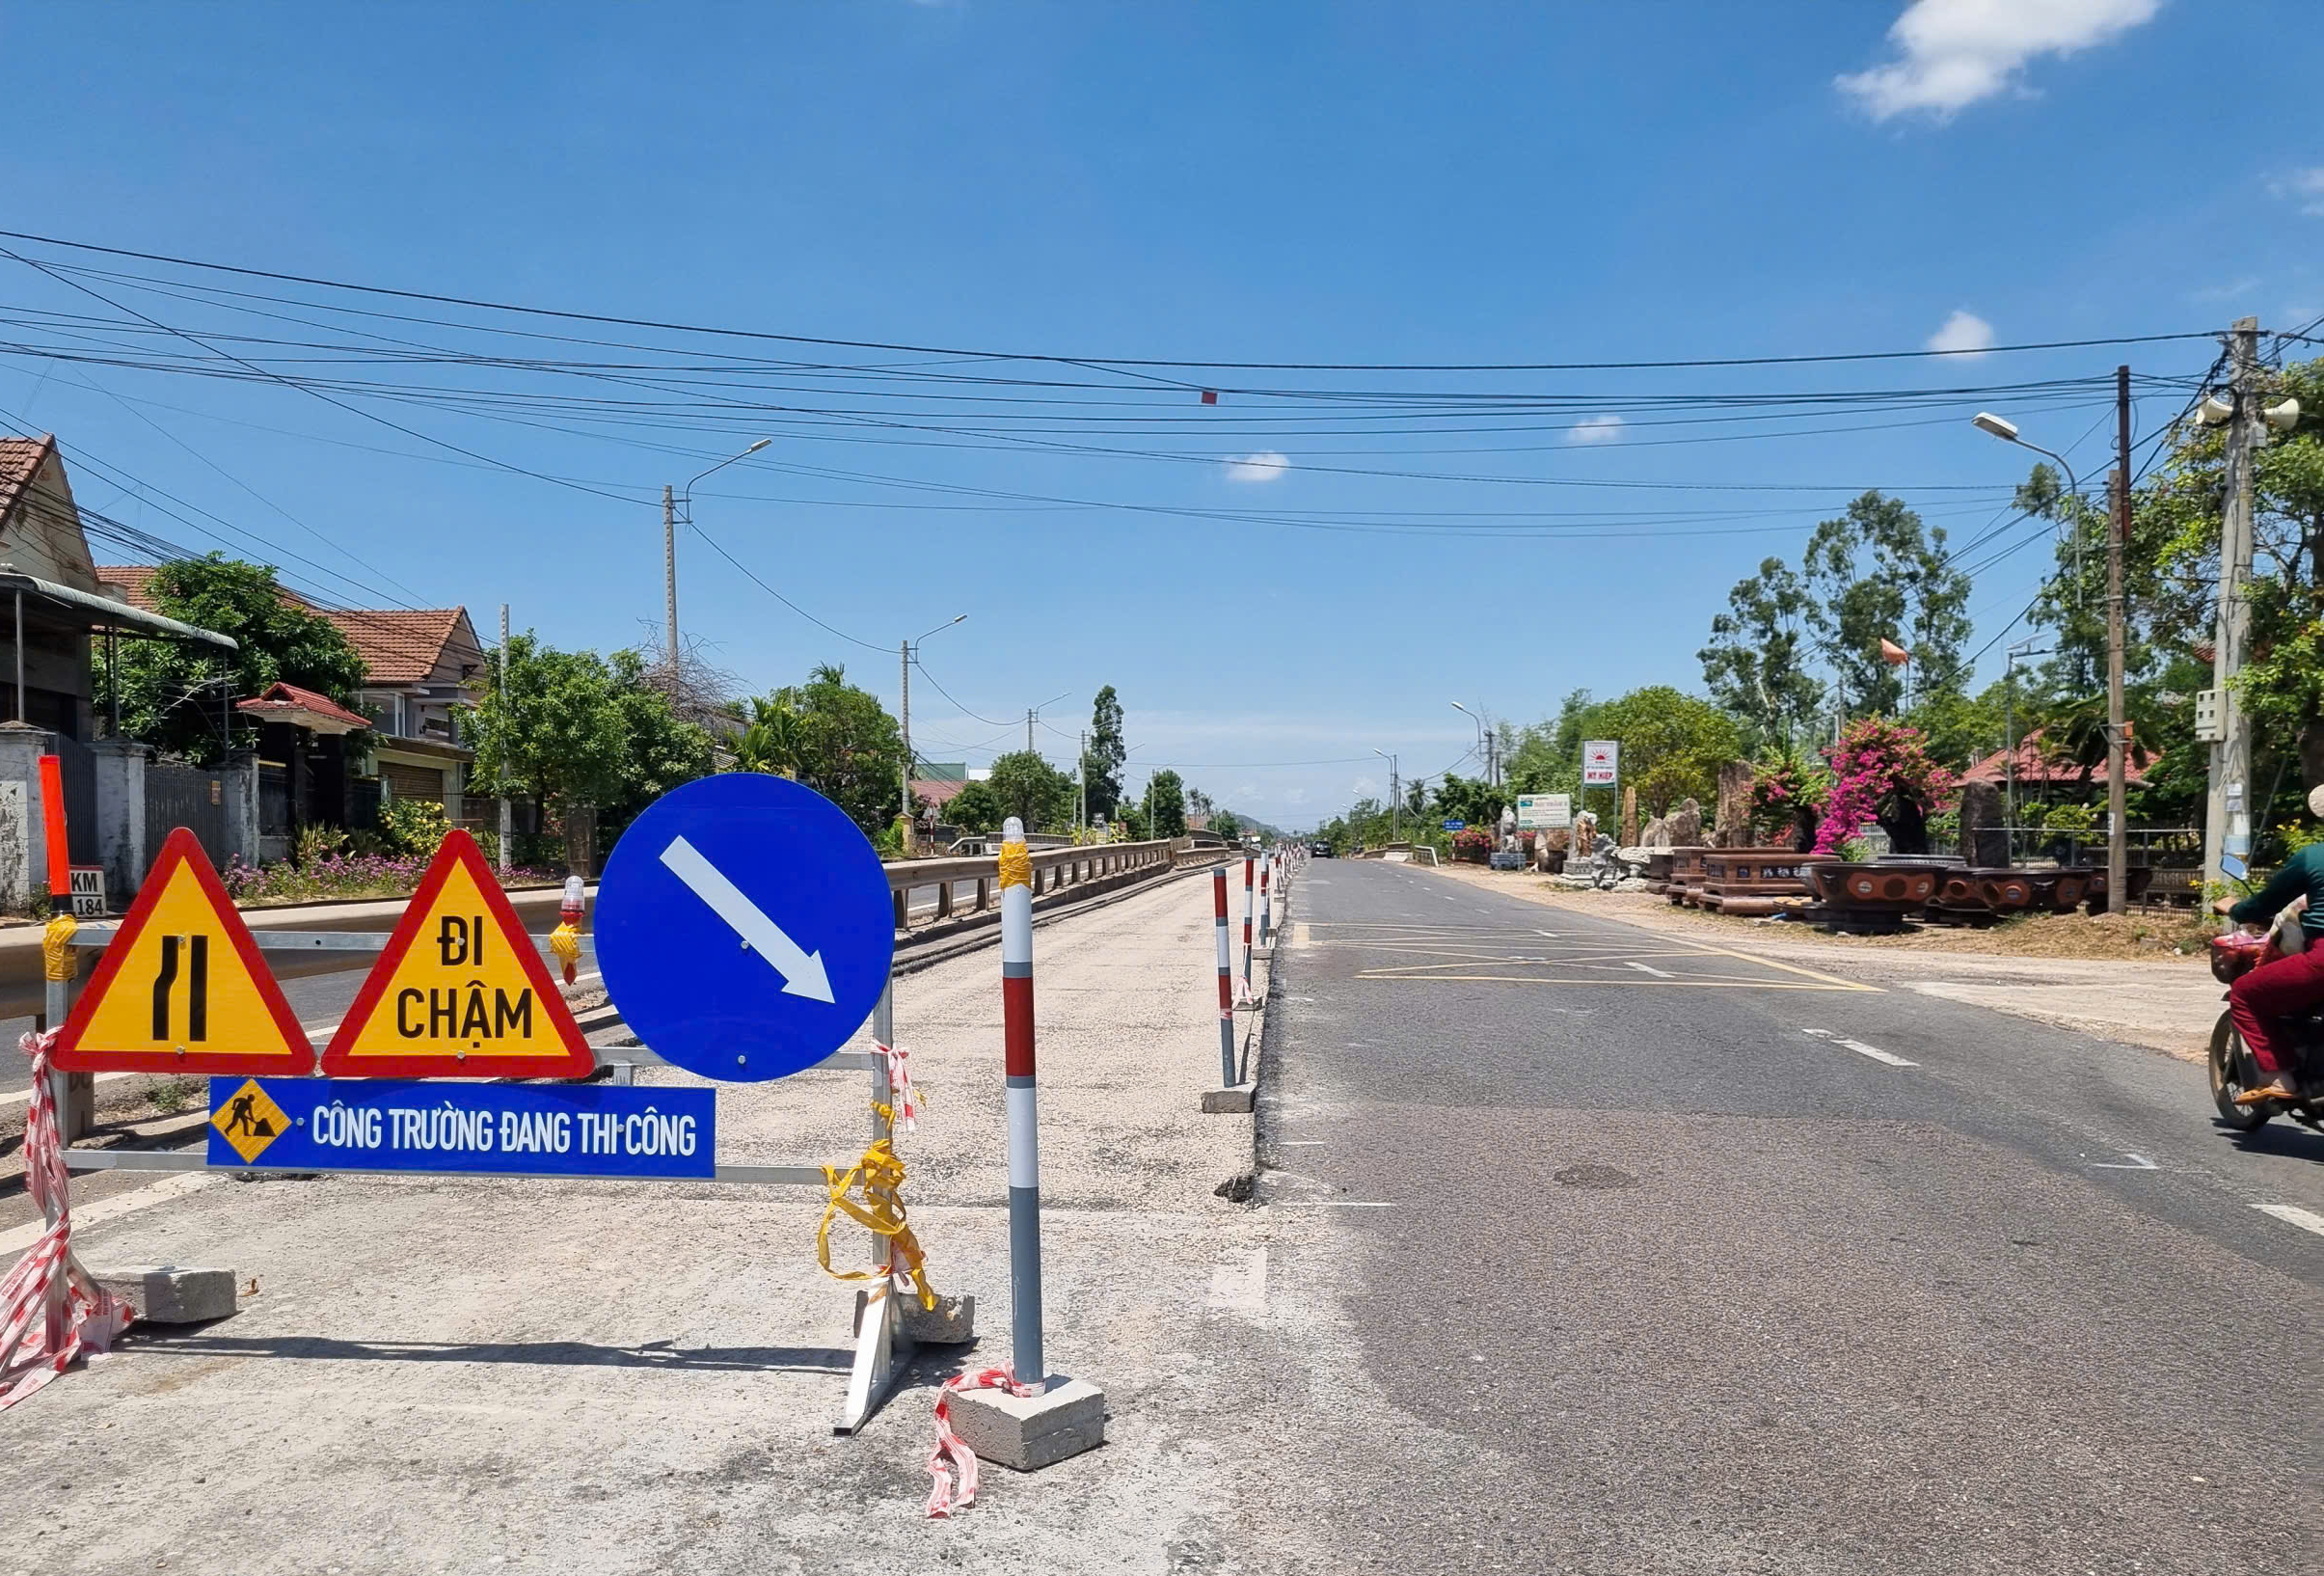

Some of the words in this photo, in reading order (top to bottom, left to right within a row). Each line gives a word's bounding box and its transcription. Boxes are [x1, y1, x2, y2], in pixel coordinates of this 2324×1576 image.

[70, 872, 97, 892] KM
[77, 898, 103, 915] 184
[437, 915, 482, 965] ĐI
[397, 979, 532, 1048] CHẬM
[312, 1100, 382, 1149] CÔNG
[389, 1100, 493, 1152] TRƯỜNG
[500, 1111, 571, 1154] ĐANG
[577, 1112, 617, 1155] THI
[625, 1105, 697, 1156] CÔNG
